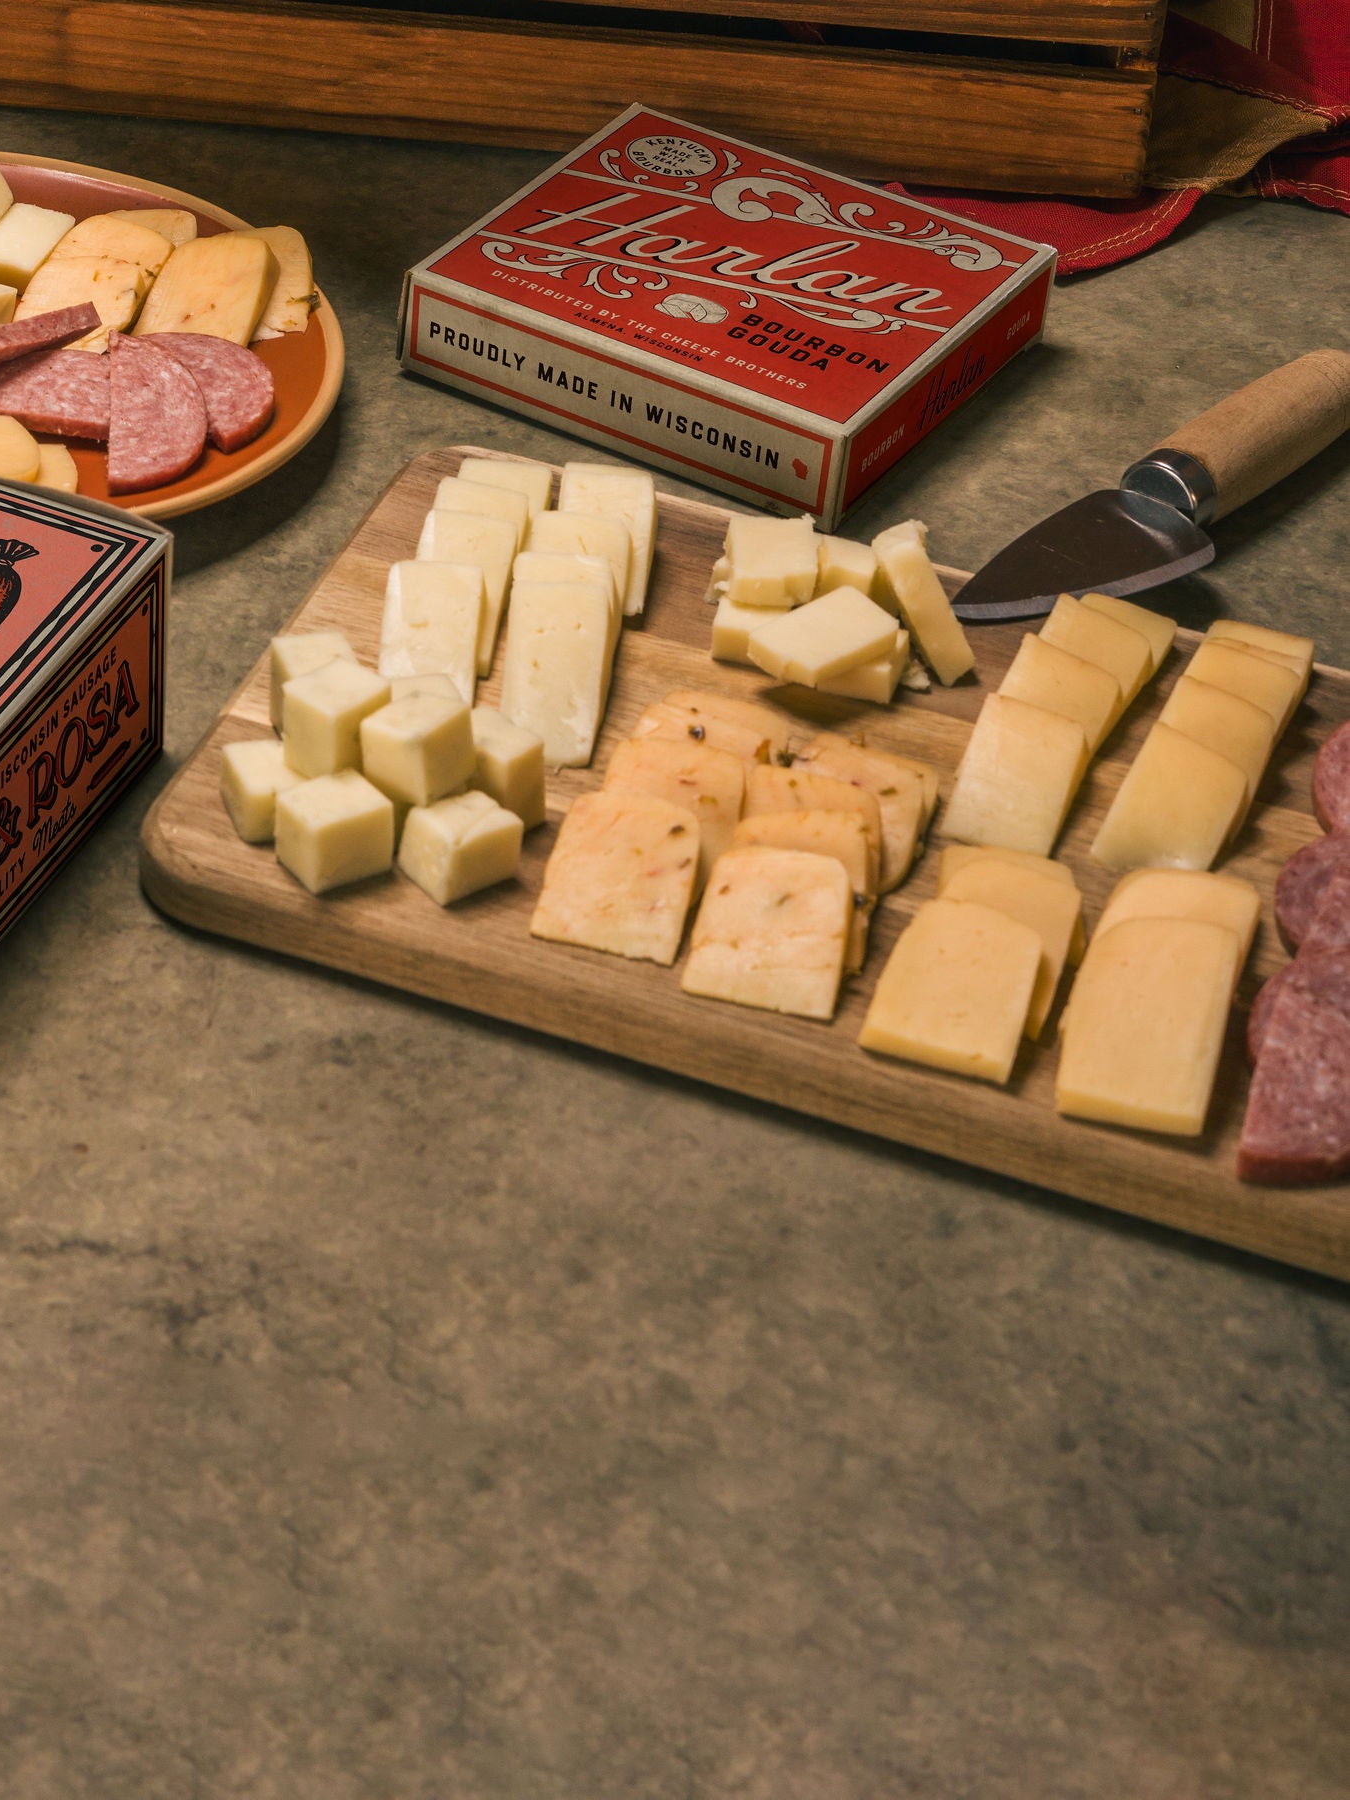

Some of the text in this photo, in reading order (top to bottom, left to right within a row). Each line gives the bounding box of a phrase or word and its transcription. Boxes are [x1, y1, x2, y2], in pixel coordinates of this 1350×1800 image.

[633, 151, 695, 176] BOURBON
[645, 138, 711, 165] KENTUCKY
[652, 155, 678, 167] REAL
[659, 151, 686, 163] WITH
[663, 146, 692, 159] MADE
[518, 191, 953, 316] Harlan
[491, 269, 808, 391] DISTRIBUTED BY THE CHEESE BROTHERS
[633, 332, 705, 363] WISCONSIN
[727, 326, 830, 372] GOUDA
[741, 312, 891, 374] BOURBON
[1006, 311, 1032, 341] GOUDA
[428, 320, 781, 470] PROUDLY MADE IN WISCONSIN
[918, 344, 987, 432] Harlan
[860, 423, 906, 473] BOURBON
[62, 645, 118, 720] SAUSAGE
[26, 659, 141, 830] ROSA
[31, 793, 78, 857] Meats
